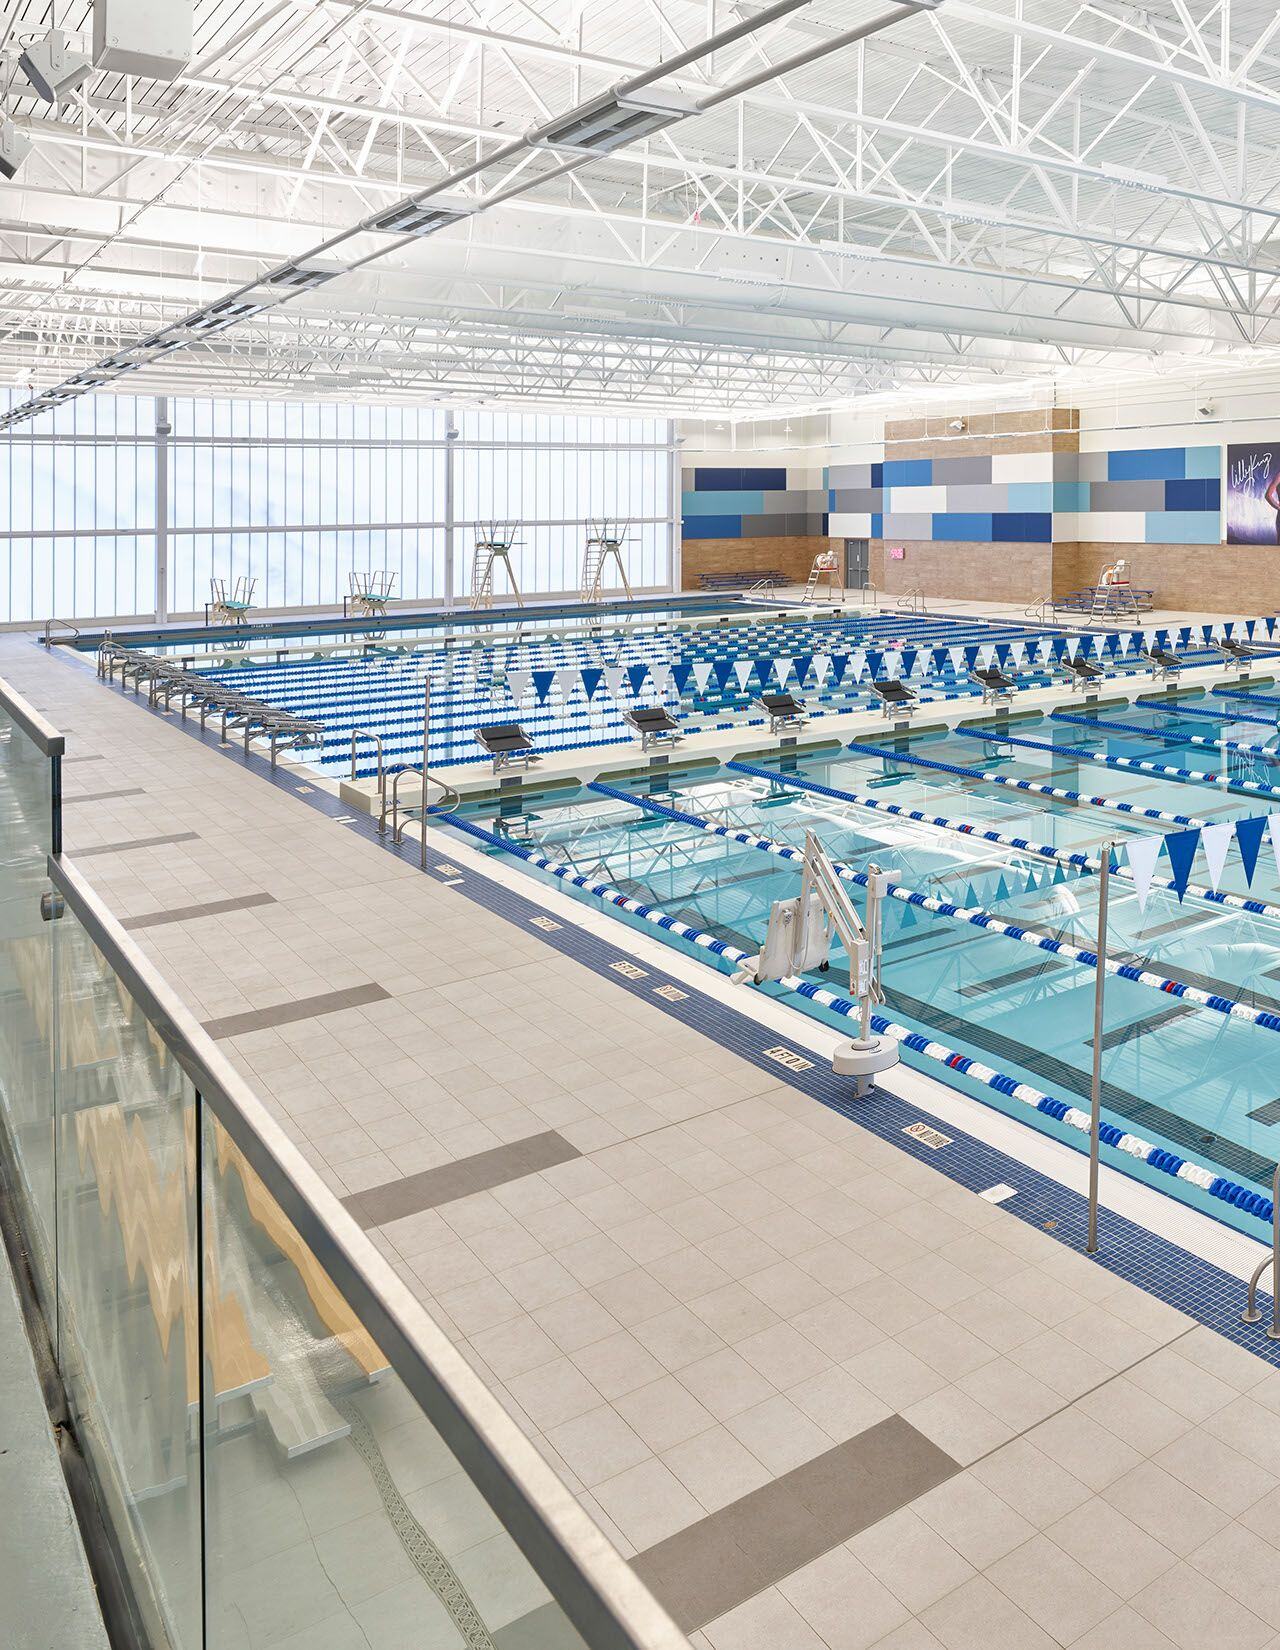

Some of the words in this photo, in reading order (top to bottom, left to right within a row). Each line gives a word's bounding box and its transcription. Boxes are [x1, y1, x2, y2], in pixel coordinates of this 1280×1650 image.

[774, 1052, 794, 1060] FT
[793, 1061, 811, 1070] IN
[916, 1130, 934, 1138] NO
[924, 1133, 950, 1148] DIVING
